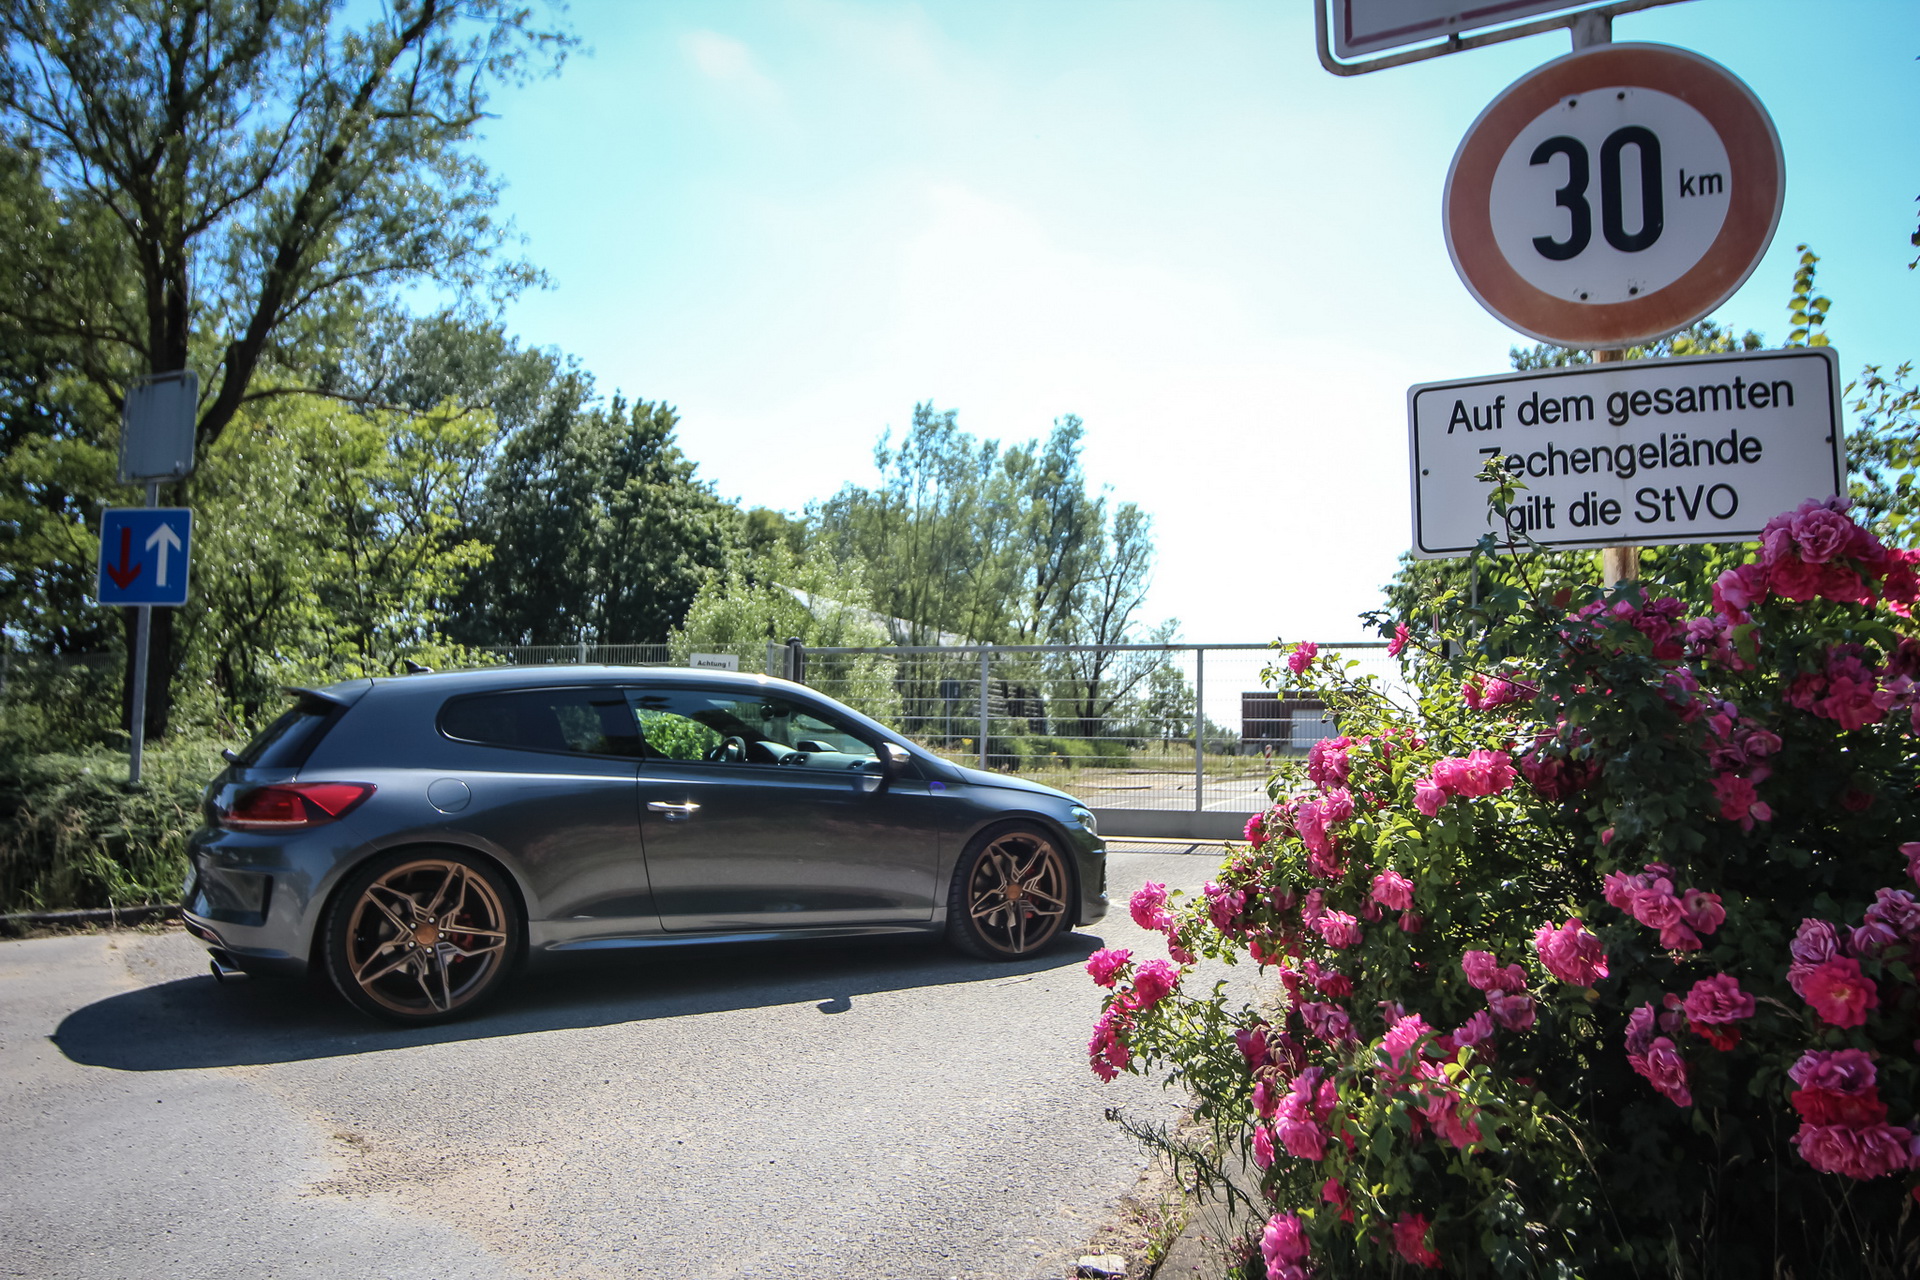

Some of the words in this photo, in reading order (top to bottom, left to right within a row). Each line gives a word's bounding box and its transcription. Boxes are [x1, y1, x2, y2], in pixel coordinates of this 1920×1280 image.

[1529, 125, 1664, 261] 30
[1679, 168, 1723, 198] km
[1447, 395, 1506, 434] Auf
[1517, 391, 1594, 427] dem
[1606, 376, 1795, 426] gesamten
[1507, 495, 1555, 533] gilt
[1568, 491, 1622, 528] die
[1634, 483, 1739, 524] StVO
[698, 660, 727, 668] Achtung
